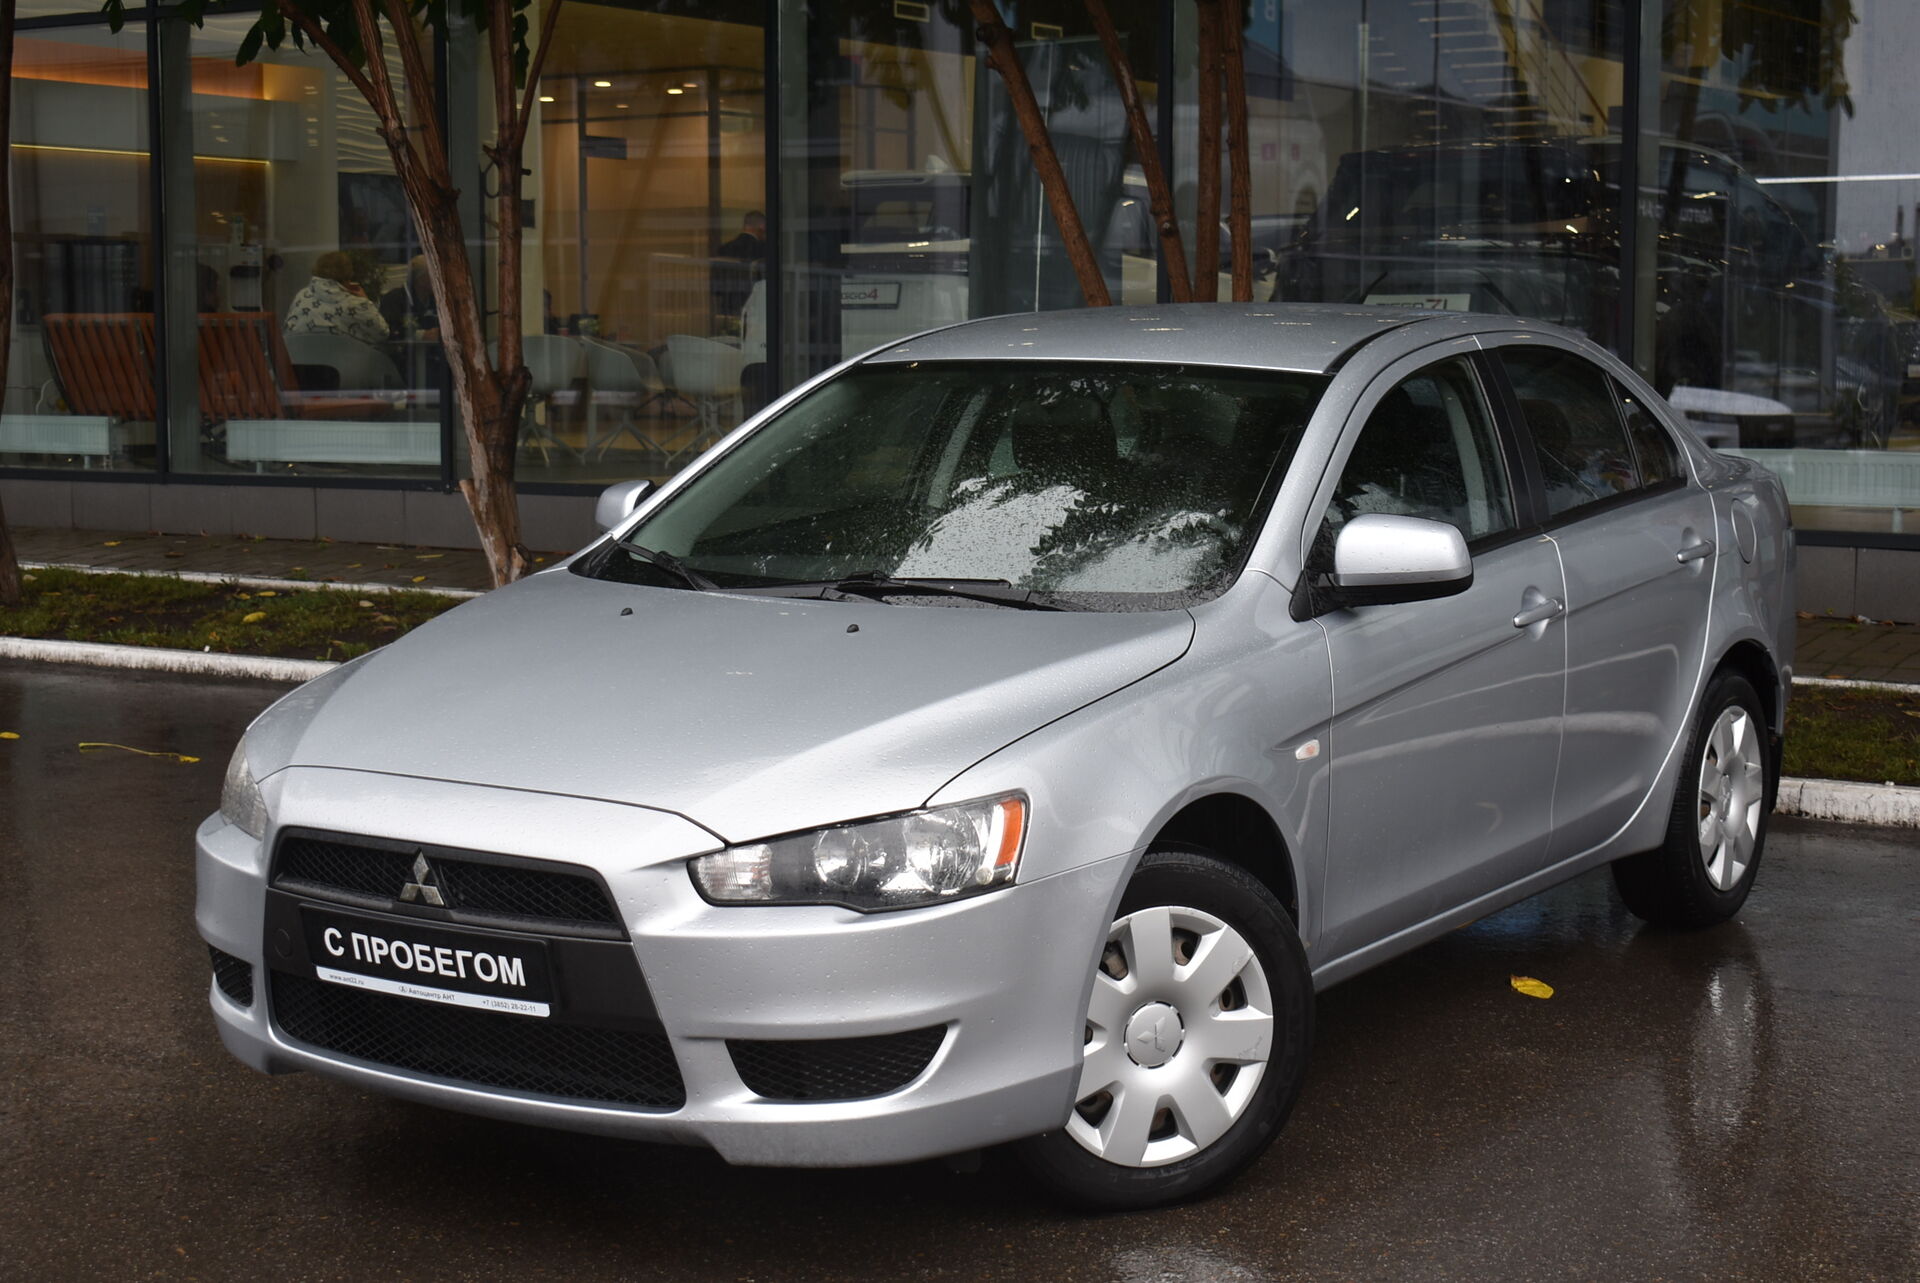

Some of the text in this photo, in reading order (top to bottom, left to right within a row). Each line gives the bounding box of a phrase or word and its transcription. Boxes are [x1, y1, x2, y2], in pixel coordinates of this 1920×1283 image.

[324, 927, 526, 987] С ПРОБЕГОМ
[408, 987, 456, 1001] Автоцентр АНТ
